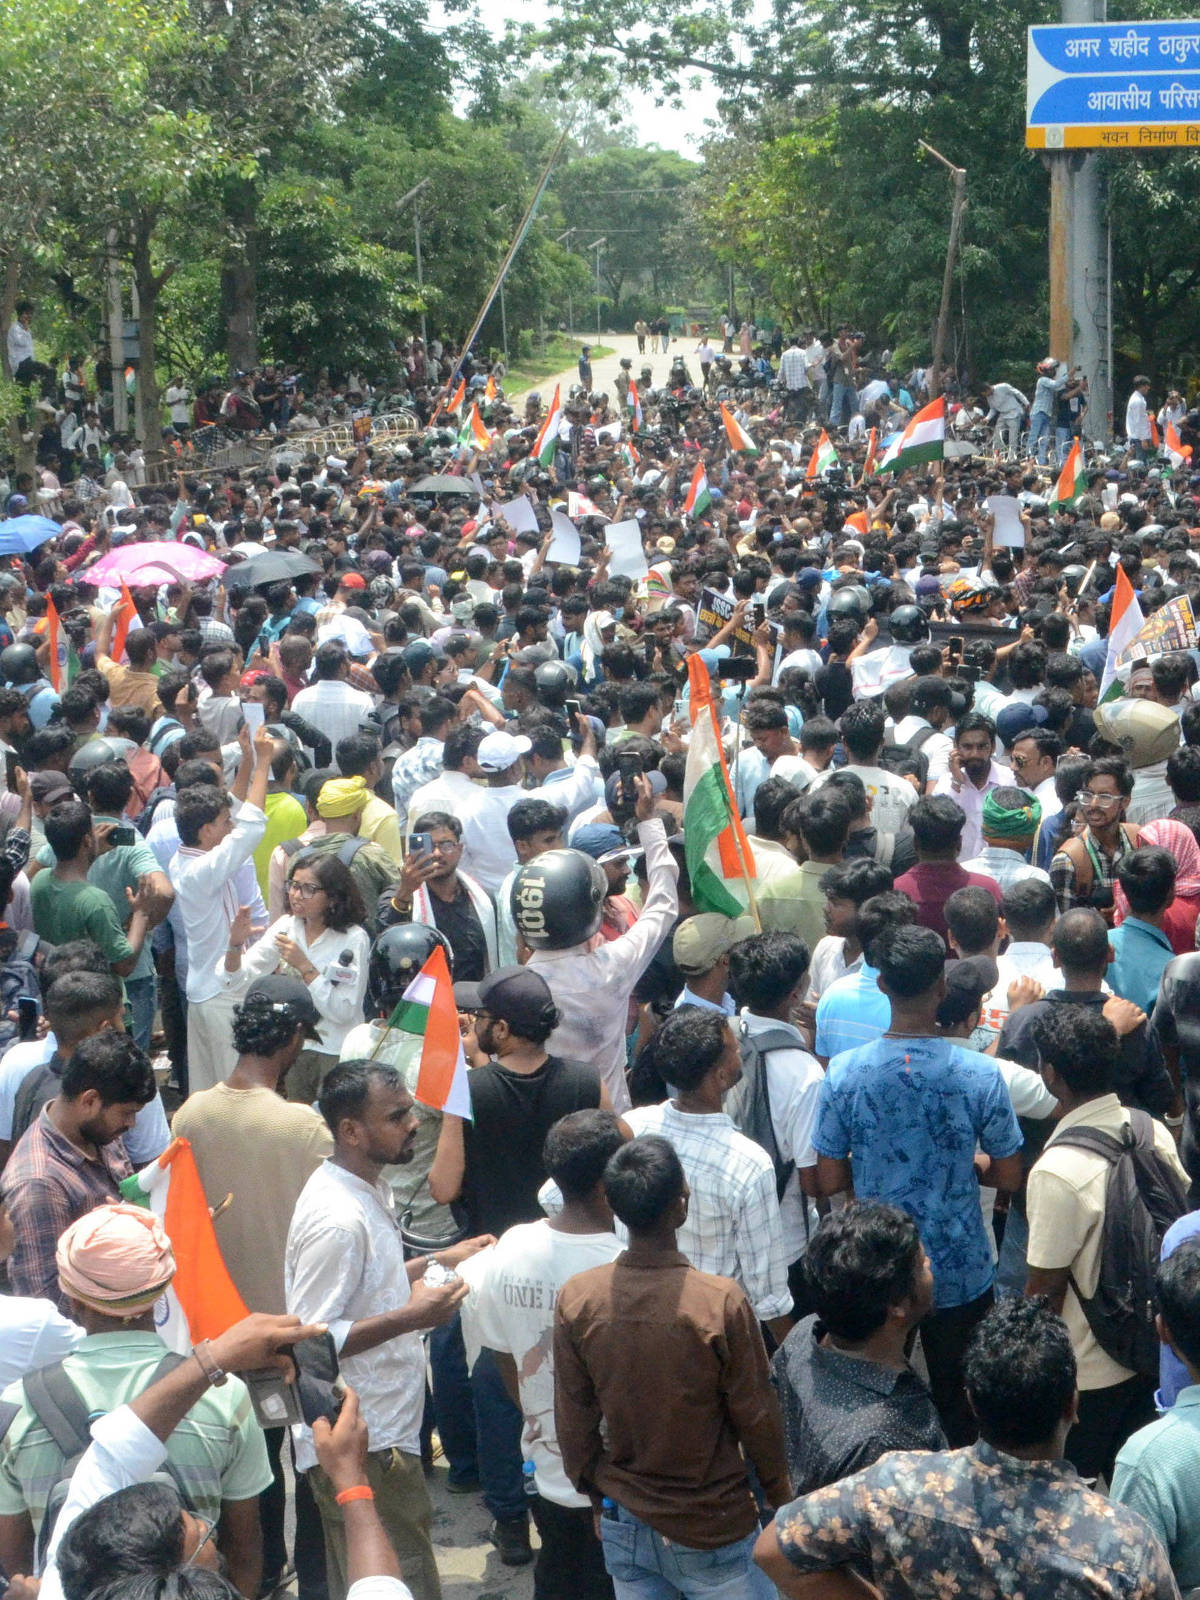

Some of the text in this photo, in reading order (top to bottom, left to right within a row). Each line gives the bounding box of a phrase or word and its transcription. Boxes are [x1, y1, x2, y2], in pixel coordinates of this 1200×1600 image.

[1064, 39, 1101, 58] अमर
[1108, 29, 1151, 58] शहीद
[1158, 35, 1200, 63] ठाकुर
[1087, 83, 1151, 110] आवासीय
[1101, 131, 1129, 143] भवन
[1138, 126, 1177, 143] निर्माण
[519, 876, 550, 938] 1901
[503, 1283, 543, 1309] ONE
